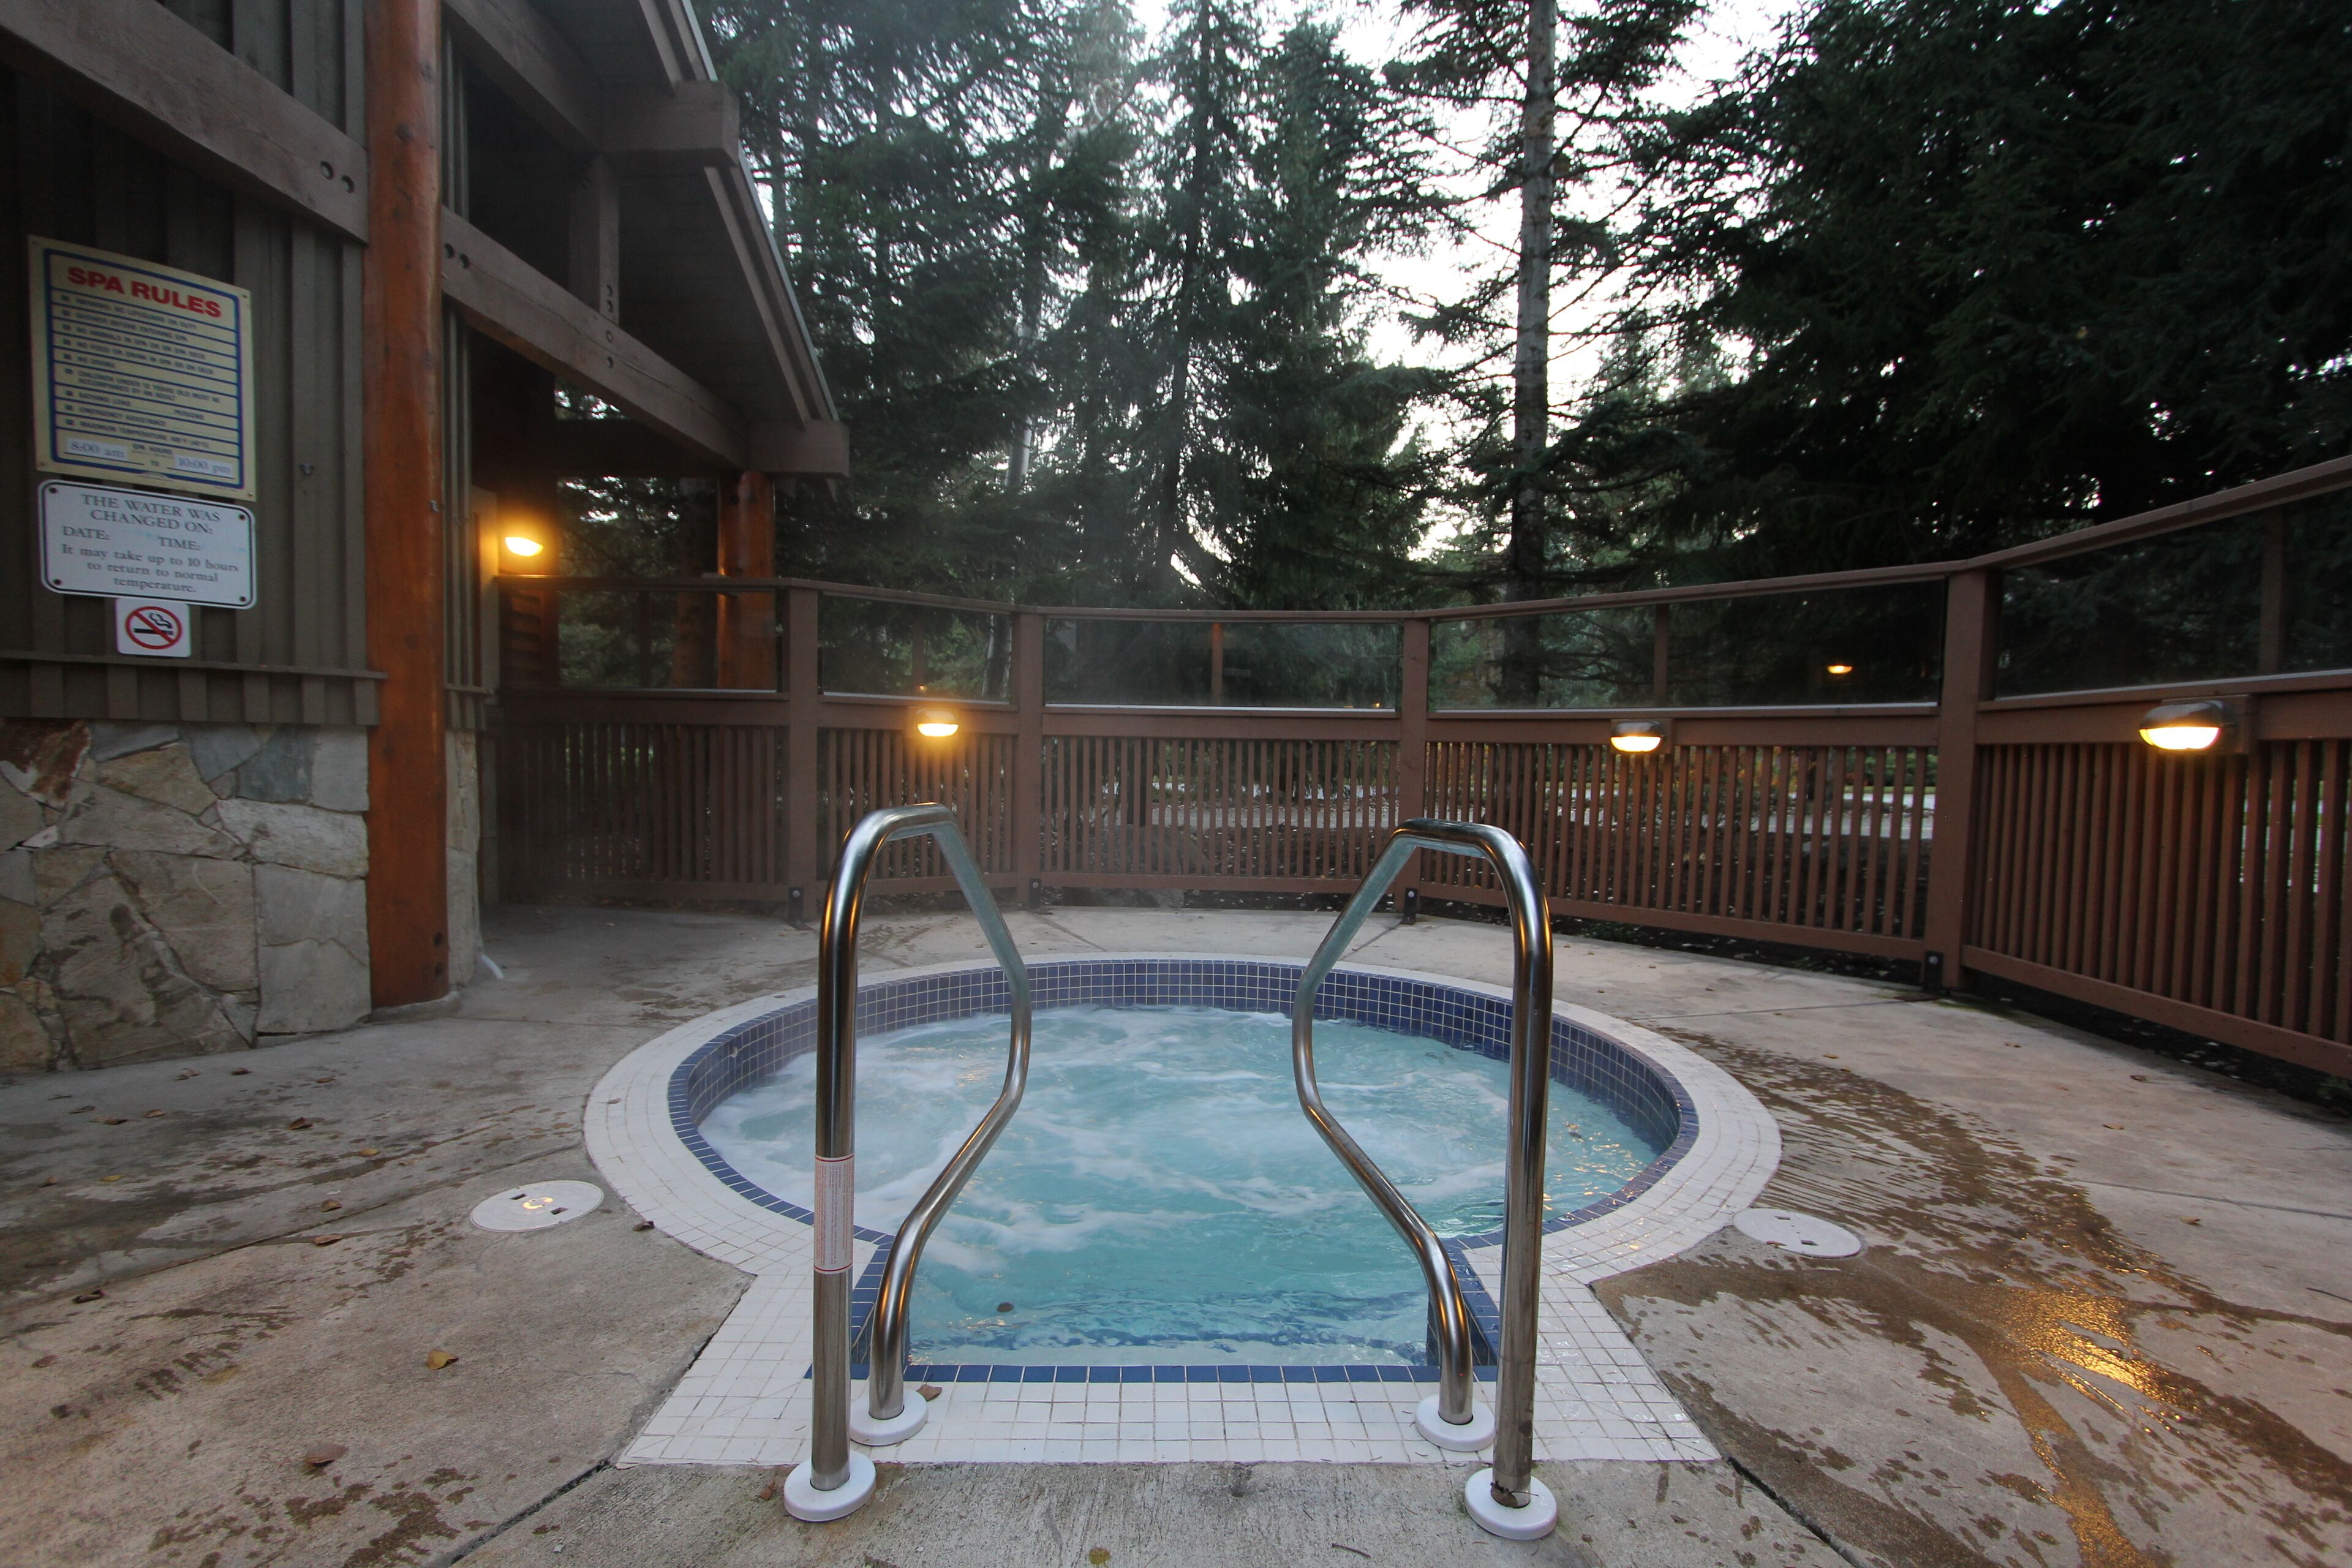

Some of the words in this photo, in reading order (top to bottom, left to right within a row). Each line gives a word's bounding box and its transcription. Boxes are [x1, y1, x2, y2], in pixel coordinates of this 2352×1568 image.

[67, 267, 125, 294] SPA
[131, 281, 222, 318] RULES
[70, 441, 99, 453] 8:00
[105, 449, 124, 458] am
[179, 457, 208, 469] 10:00
[213, 465, 231, 473] pm
[81, 494, 119, 508] THE
[125, 499, 183, 517] WATER
[187, 508, 221, 522] WAS
[91, 509, 179, 529] CHANGED
[185, 522, 213, 534] ON:
[62, 526, 110, 540] DATE:
[158, 536, 201, 550] TIME:
[62, 544, 72, 554] It
[80, 548, 108, 559] may
[115, 550, 143, 562] take
[148, 556, 165, 565] up
[170, 556, 183, 566] to
[188, 558, 200, 567] 10
[205, 559, 239, 572] hours
[87, 562, 101, 571] to
[107, 564, 149, 575] return
[156, 568, 169, 577] to
[174, 571, 219, 582] normal
[114, 576, 197, 593] temperature.
